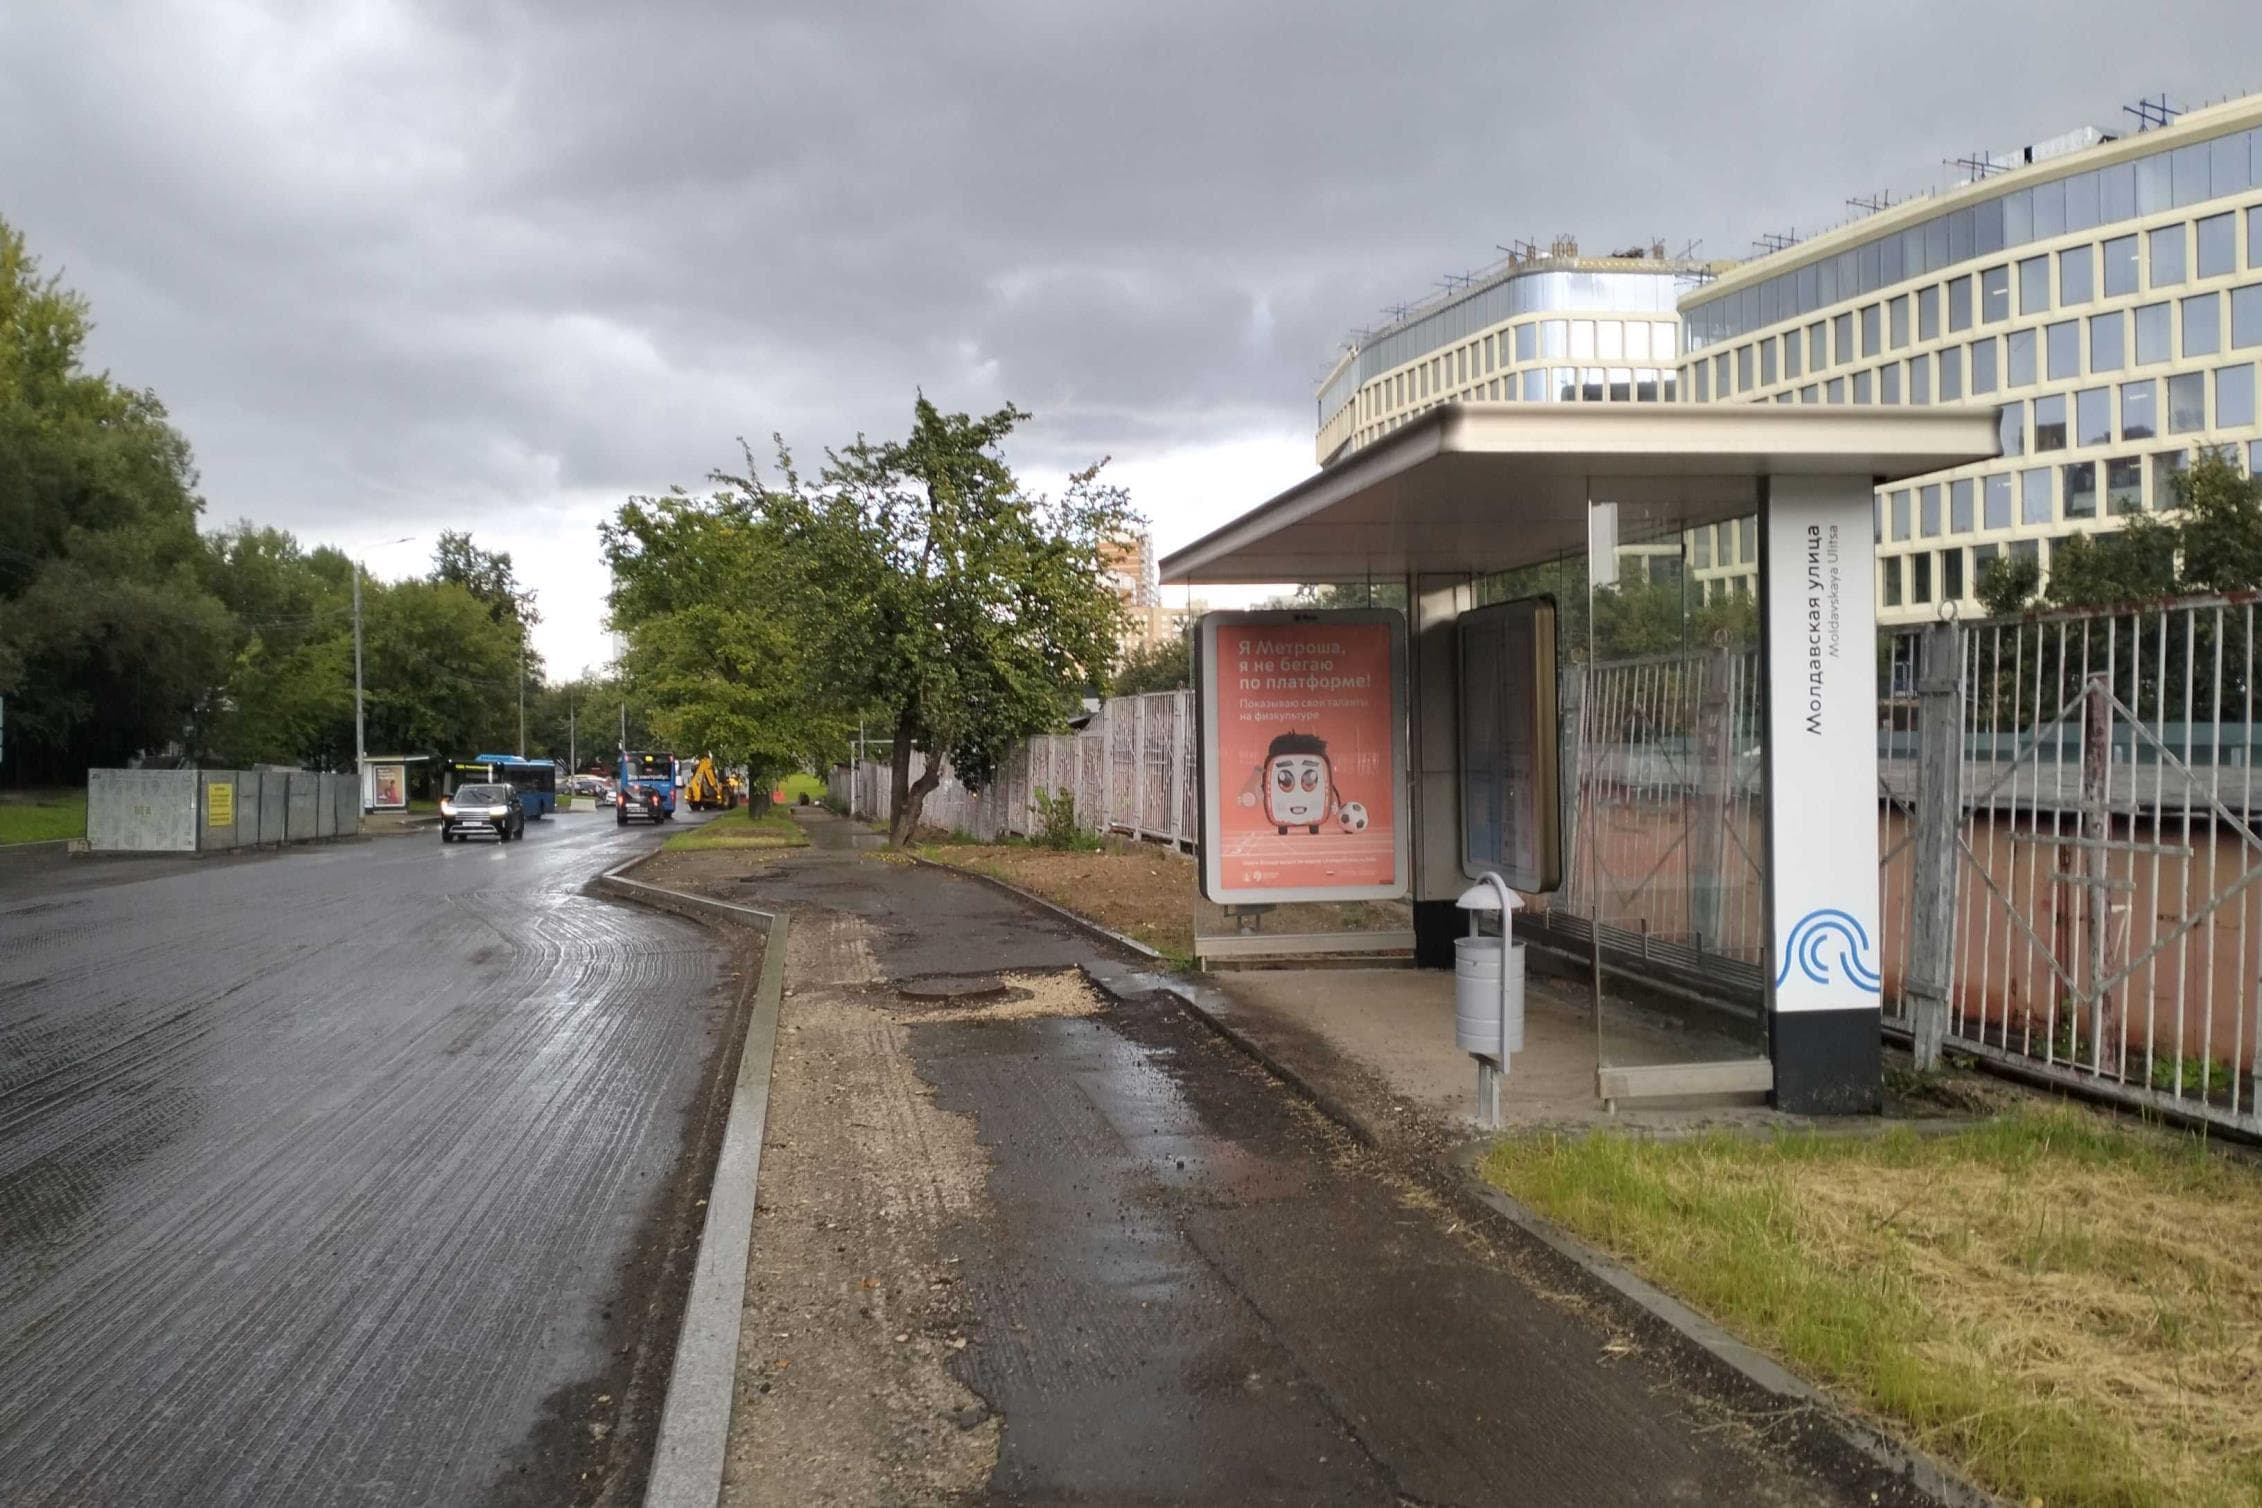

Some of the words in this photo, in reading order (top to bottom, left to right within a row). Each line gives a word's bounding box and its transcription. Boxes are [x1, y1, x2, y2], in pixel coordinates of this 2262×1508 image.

[1827, 524, 1839, 561] Ulitsa
[1808, 524, 1824, 590] улица
[1828, 567, 1841, 658] Moldavskaya
[1239, 641, 1250, 655] Я
[1256, 640, 1347, 657] Метроша,
[1239, 660, 1248, 672] я
[1254, 660, 1274, 672] не
[1280, 657, 1334, 672] бегаю
[1806, 597, 1823, 735] Молдавская
[1240, 677, 1260, 689] по
[1267, 673, 1371, 691] платформе!
[1240, 698, 1299, 709] Показываю
[1301, 699, 1327, 708] свои
[1240, 712, 1252, 721] на
[1254, 710, 1320, 722] физкультуре
